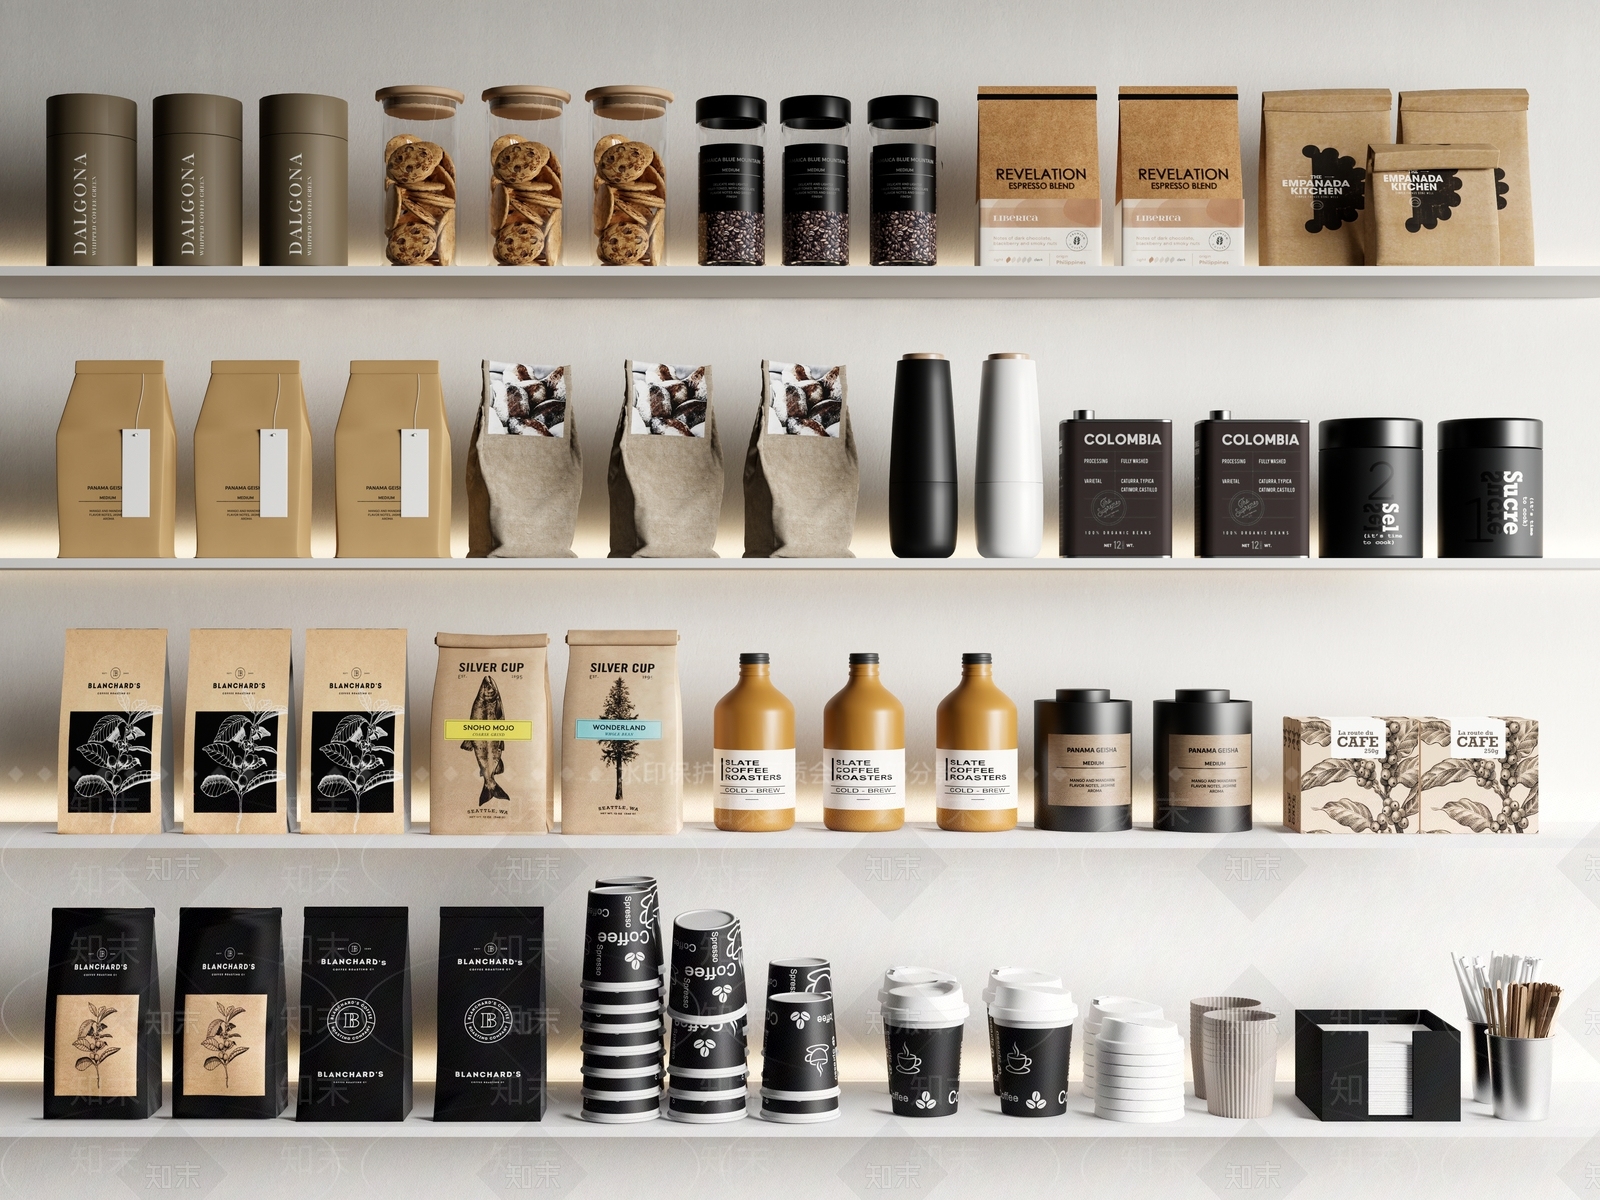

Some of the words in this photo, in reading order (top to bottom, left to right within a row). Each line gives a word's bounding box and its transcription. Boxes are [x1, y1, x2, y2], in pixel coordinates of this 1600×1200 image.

[996, 168, 1086, 180] REVELATION
[1139, 168, 1229, 180] REVELATION
[73, 153, 87, 255] DALGONA
[181, 153, 195, 255] DALGONA
[289, 153, 302, 255] DALGONA
[1084, 434, 1161, 445] COLOMBIA
[1222, 434, 1299, 445] COLOMBIA
[1368, 461, 1394, 500] 2
[1503, 471, 1523, 535] Sucre
[1382, 503, 1399, 532] Sel
[459, 663, 497, 672] SILVER
[501, 663, 524, 672] CUP
[590, 663, 628, 672] SILVER
[632, 663, 655, 673] CUP
[1337, 736, 1379, 748] CAFE
[1456, 736, 1499, 748] CAFE
[598, 930, 650, 946] Coffee
[710, 931, 718, 962] Spresso
[684, 963, 736, 980] Coffee
